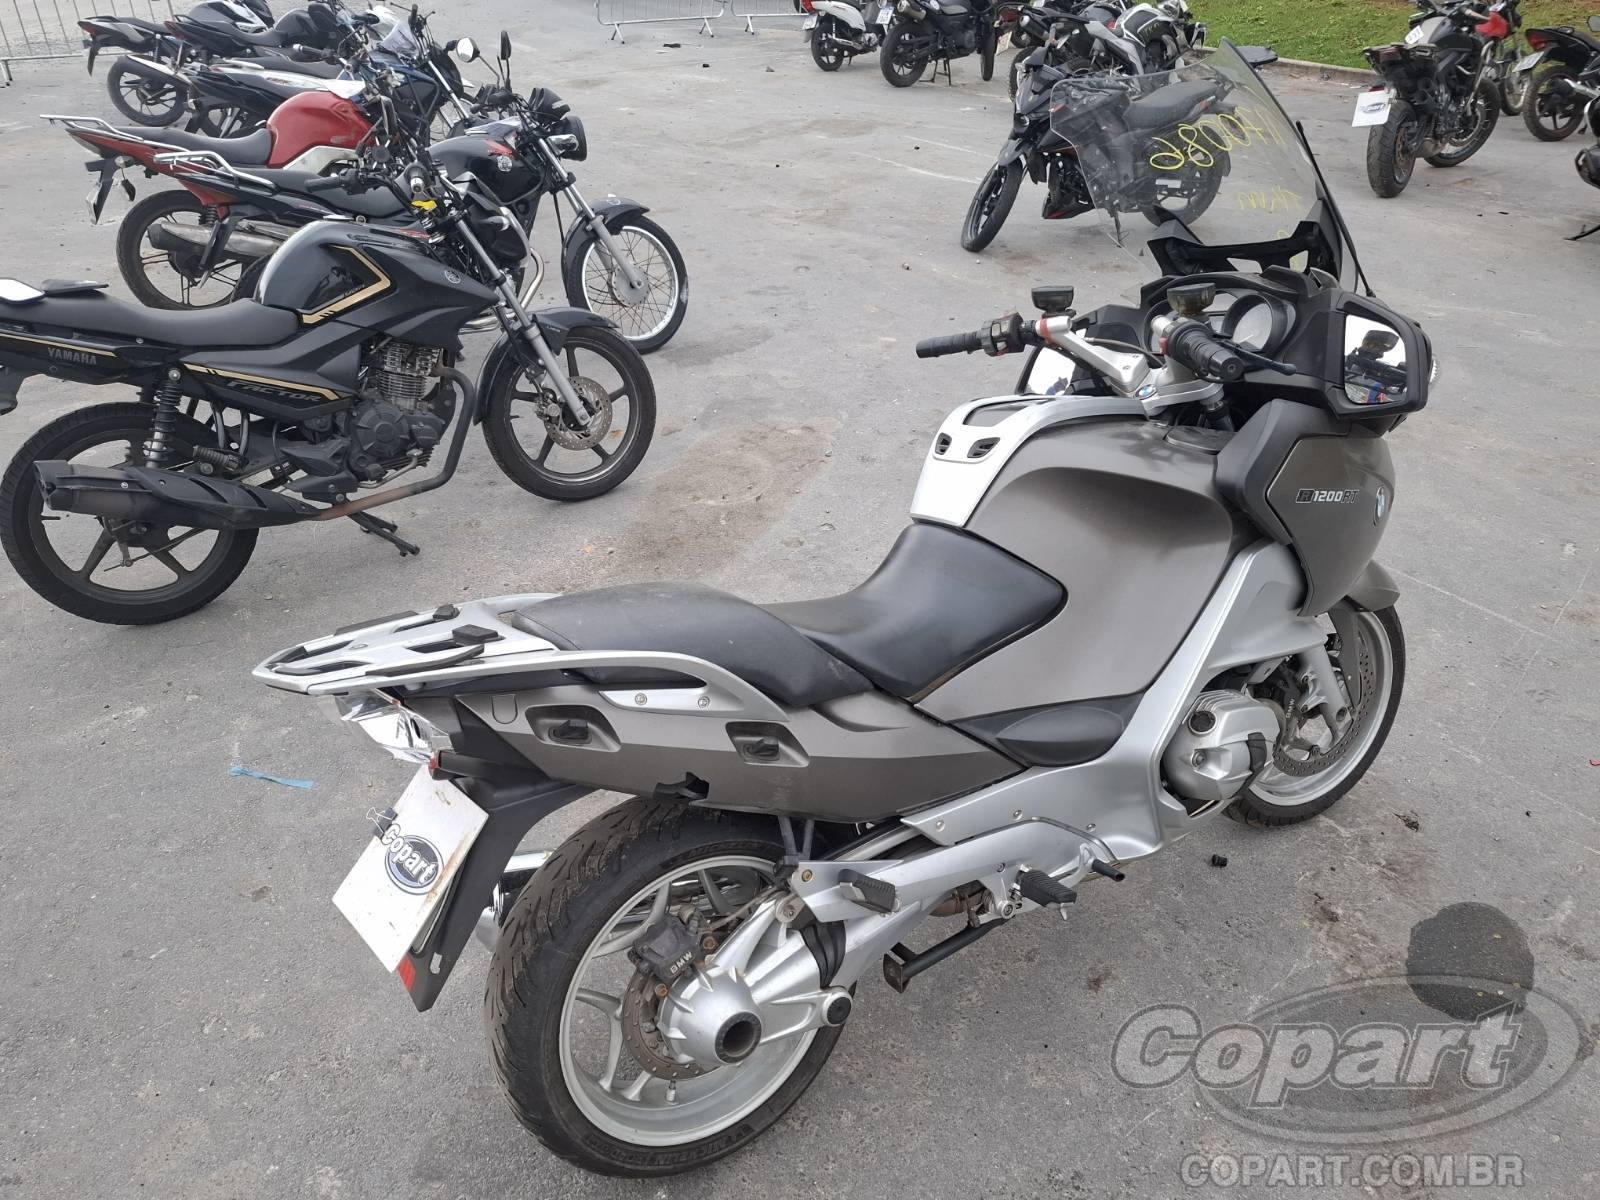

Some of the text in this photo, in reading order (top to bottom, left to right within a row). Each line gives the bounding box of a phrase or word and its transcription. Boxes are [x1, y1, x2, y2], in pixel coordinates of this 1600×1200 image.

[47, 346, 97, 366] YAMAHA
[227, 380, 321, 401] FACTOR
[381, 823, 437, 885] Copart
[670, 951, 693, 974] BMW
